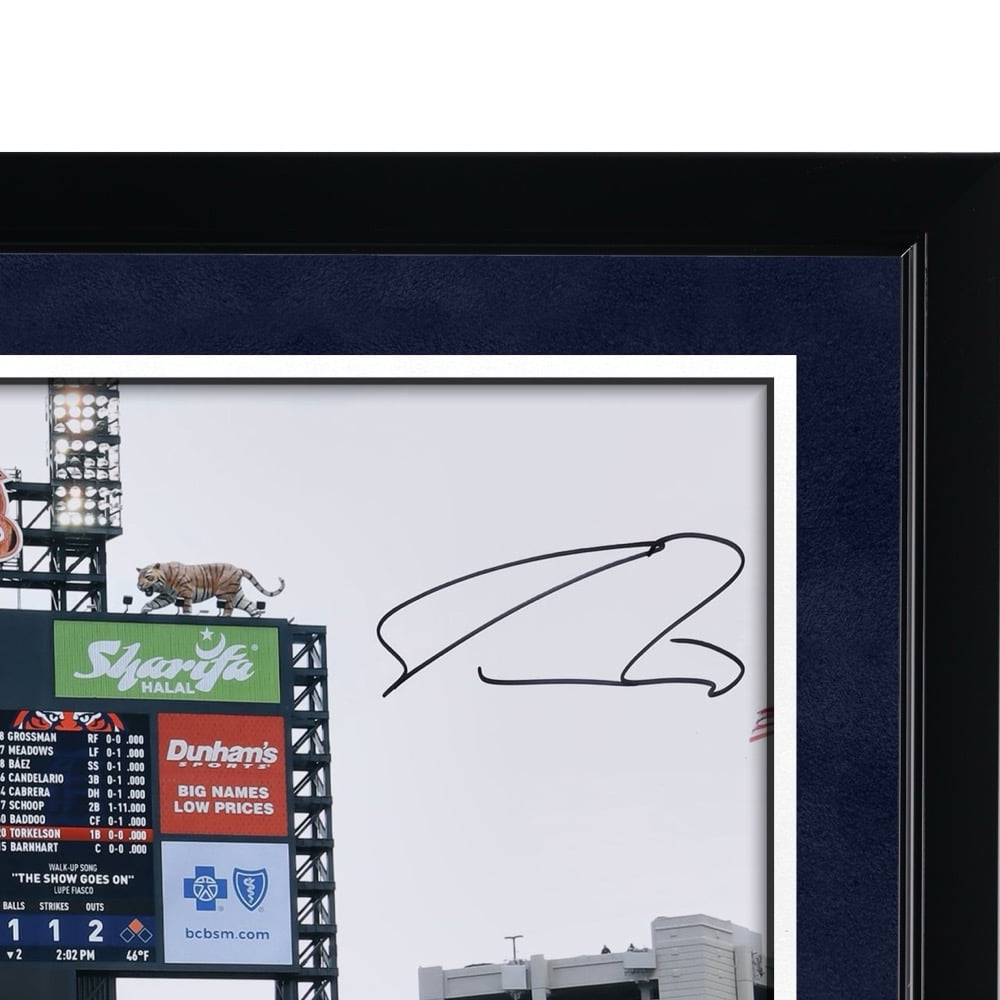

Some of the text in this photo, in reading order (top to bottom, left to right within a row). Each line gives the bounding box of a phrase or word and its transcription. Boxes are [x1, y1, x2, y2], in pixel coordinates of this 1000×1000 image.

[73, 635, 256, 692] Sharifa
[141, 680, 196, 695] HALAL
[7, 732, 57, 742] GROSSMAN
[8, 745, 54, 756] MEADOWS
[166, 739, 279, 764] Dunham's
[178, 761, 271, 770] SPORTS
[8, 772, 64, 784] CANDELARIO
[9, 786, 51, 798] CABRERA
[178, 785, 269, 799] BIG NAMES
[9, 800, 45, 811] SCHOOP
[174, 800, 274, 815] LOW PRICES
[9, 814, 46, 825] BADDOO
[10, 828, 61, 839] TORKELSON
[10, 842, 59, 853] BARNHART
[48, 863, 98, 873] WALK-UP SONG
[12, 872, 134, 885] "THE SHOW GOES ON"
[54, 886, 94, 896] LUPE FIASCO
[3, 901, 105, 912] BALLS STRIKES OUTS
[185, 927, 270, 941] bcbsm.com
[56, 949, 95, 961] 2:02 PM
